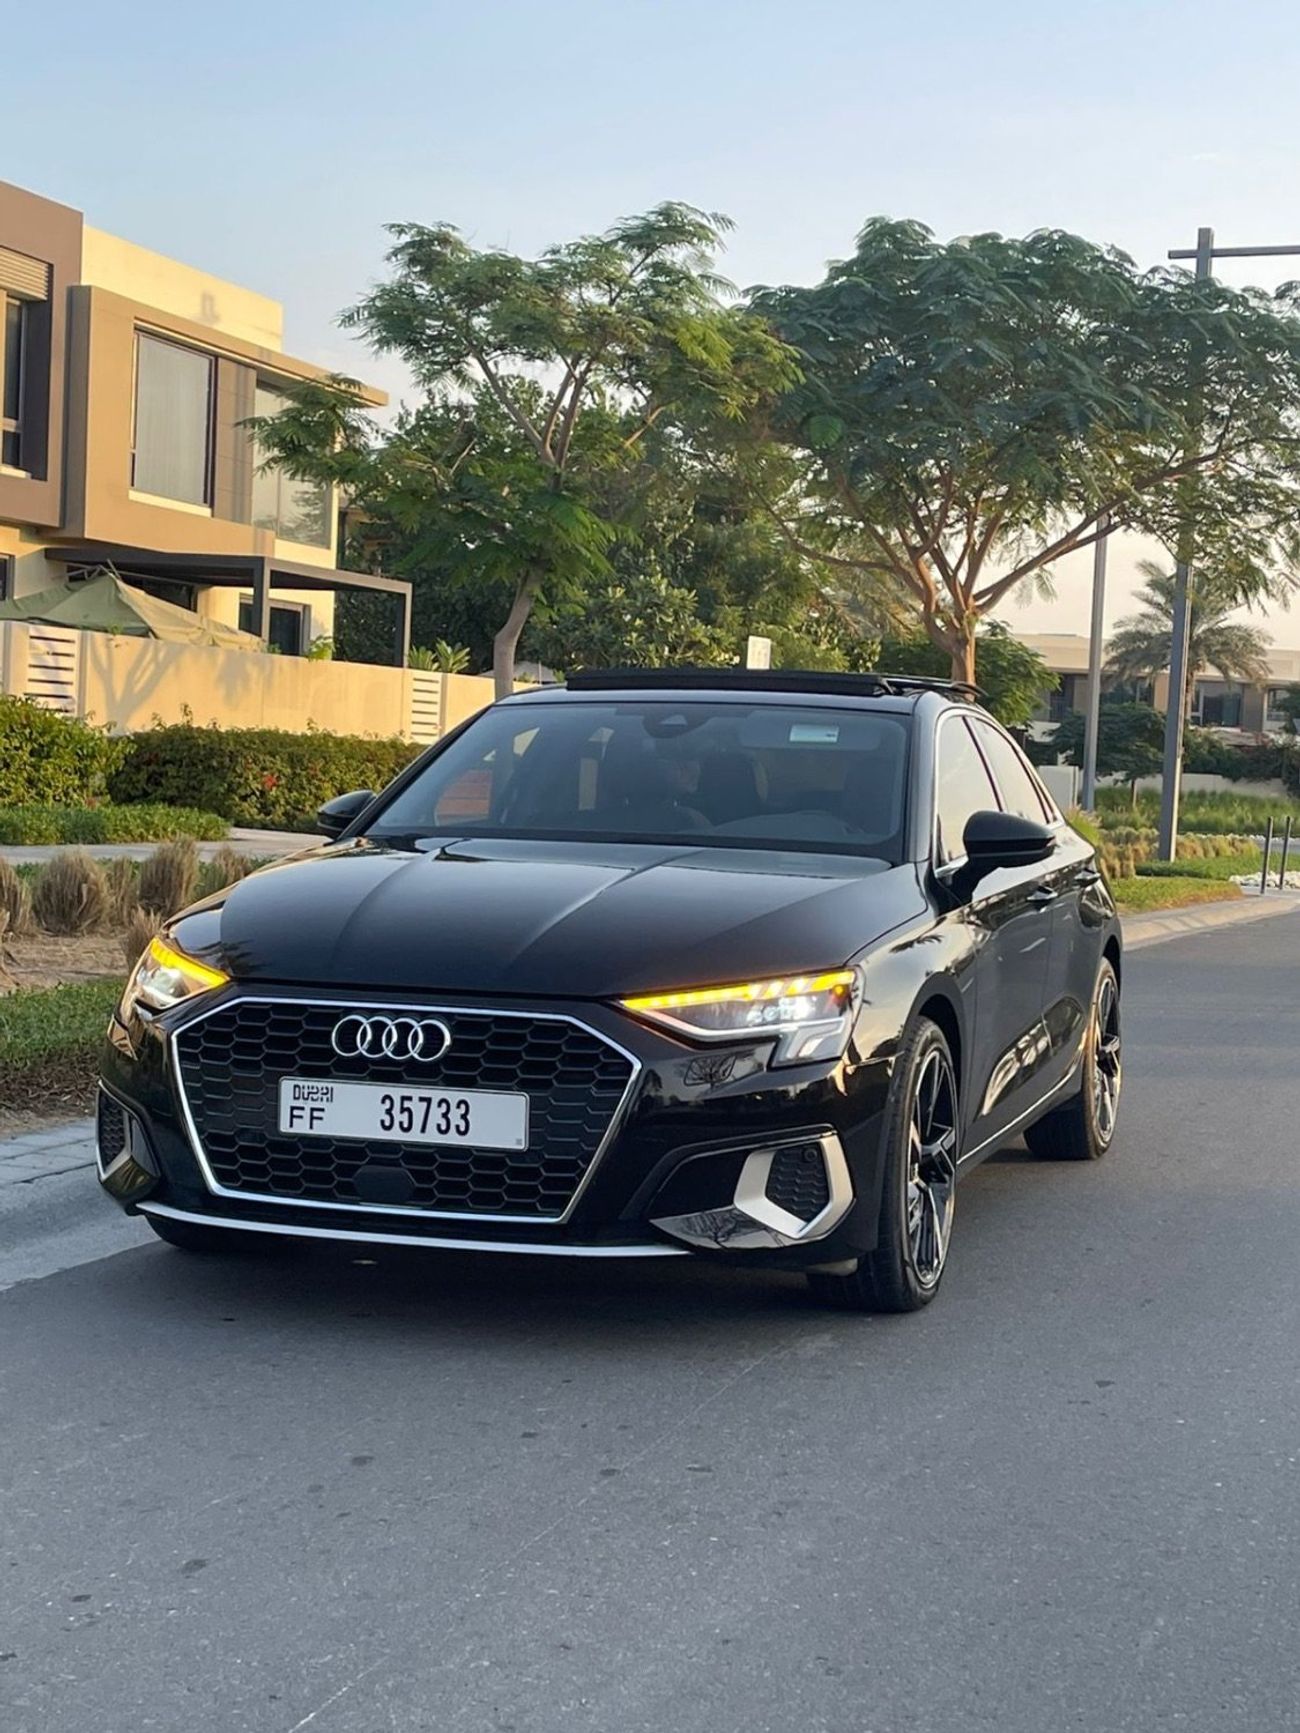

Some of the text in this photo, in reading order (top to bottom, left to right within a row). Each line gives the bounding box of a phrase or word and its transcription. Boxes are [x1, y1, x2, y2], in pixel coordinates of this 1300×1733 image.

[293, 1083, 334, 1103] DUBAI
[289, 1093, 471, 1137] FF 35733
